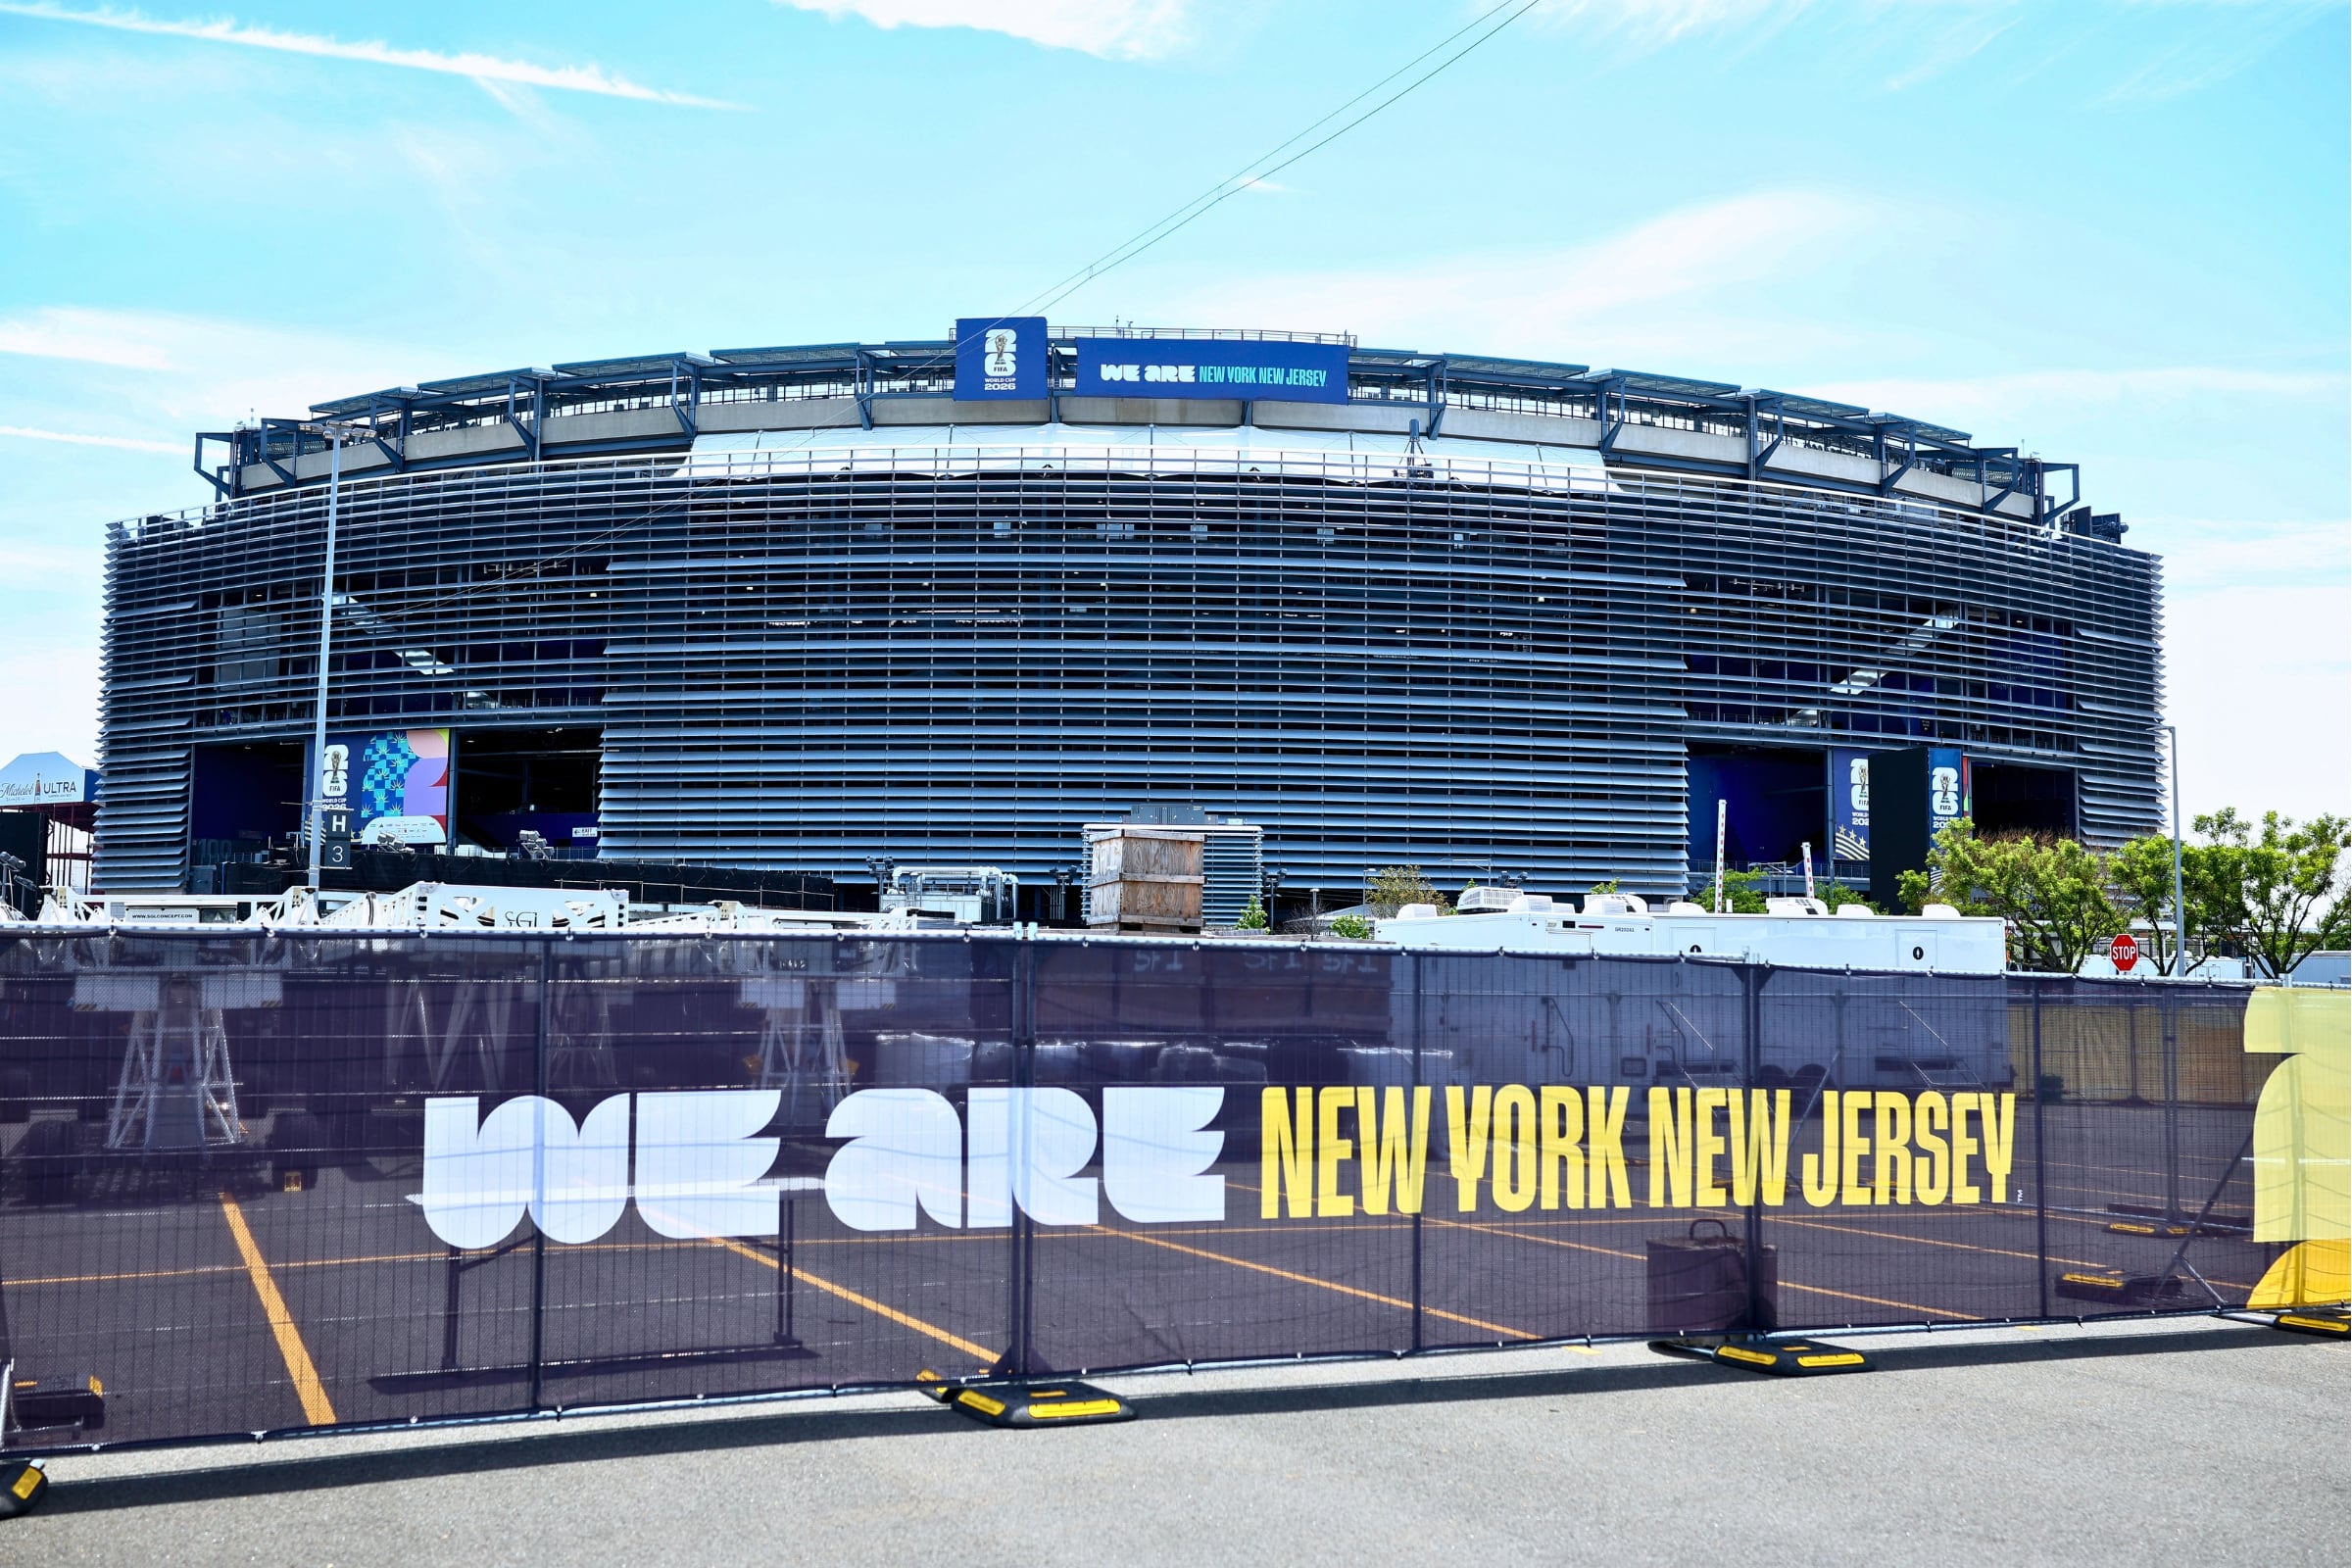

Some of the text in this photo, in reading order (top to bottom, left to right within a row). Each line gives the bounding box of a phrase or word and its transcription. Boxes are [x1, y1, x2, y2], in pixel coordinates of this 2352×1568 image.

[1100, 364, 1140, 381] WE
[1199, 366, 1225, 383] NEW
[1227, 367, 1256, 383] YORK
[1258, 368, 1284, 384] NEW
[1286, 368, 1327, 387] JERSEY
[43, 781, 76, 794] ULTRA
[331, 814, 346, 832] H
[331, 845, 343, 862] 3
[2112, 946, 2136, 960] STOP
[422, 1090, 781, 1249] WE
[825, 1087, 1225, 1231] ARE
[1261, 1086, 1430, 1219] NEW
[1445, 1083, 1631, 1212] YORK
[1649, 1087, 1791, 1208] NEW
[1802, 1091, 2016, 1207] JERSEY
